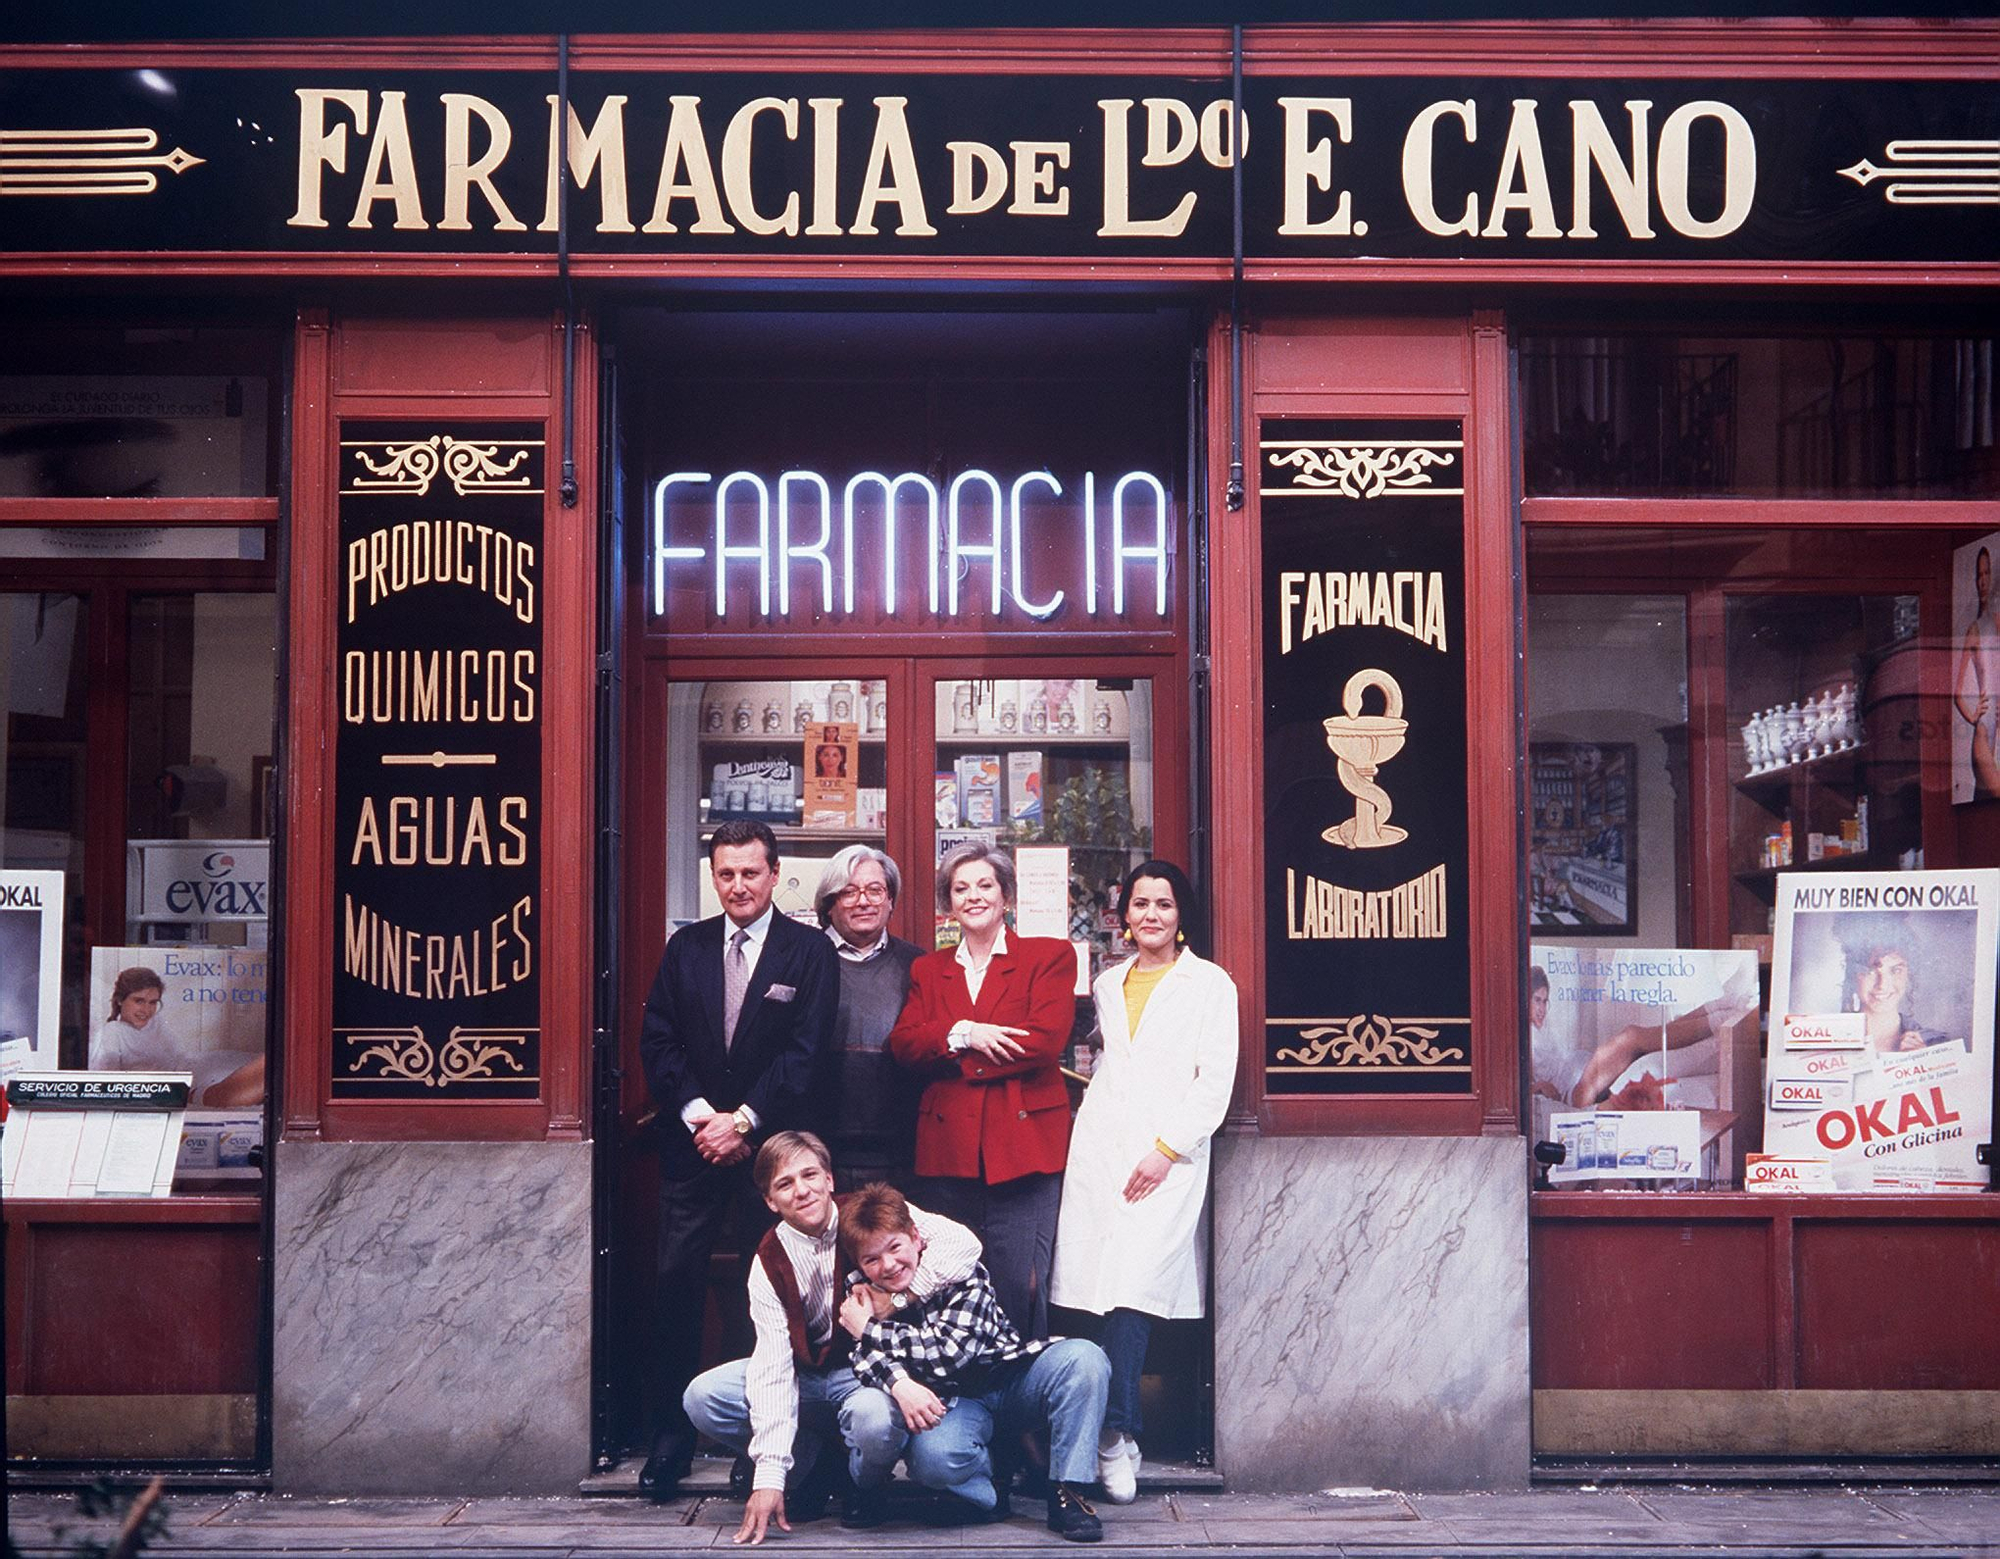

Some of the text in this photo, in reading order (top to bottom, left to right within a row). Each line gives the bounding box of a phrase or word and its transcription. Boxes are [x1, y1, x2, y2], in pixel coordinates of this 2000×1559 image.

[286, 88, 938, 238] FARMACIA
[946, 141, 1069, 215] DE
[1277, 97, 1369, 237] E.
[1401, 98, 1757, 240] CANO
[655, 470, 1167, 617] FARMACIA
[348, 520, 534, 624] PRODUCTOS
[1281, 572, 1447, 655] FARMACIA
[346, 650, 534, 725] QUIMICOS
[351, 797, 527, 865] AGUAS
[166, 881, 266, 914] evax
[1287, 863, 1447, 939] LABORATORIO
[1794, 885, 1979, 909] MUY BIEN CON OKAL
[345, 893, 531, 1000] MINERALES
[164, 954, 222, 977] Evax:
[227, 956, 247, 977] lo
[1617, 955, 1695, 981] parecido
[183, 988, 267, 1004] a no ten
[1611, 980, 1627, 1003] la
[1631, 981, 1677, 1008] regla.
[1791, 1027, 1832, 1038] OKAL
[1807, 1056, 1849, 1073] OKAL
[1895, 1065, 1927, 1079] OKAL
[18, 1082, 171, 1093] SERVICIO DE URGENCIA
[1782, 1087, 1823, 1099] OKAL
[1816, 1086, 1960, 1149] OKAL
[1864, 1126, 1963, 1158] Con Glicina
[1756, 1167, 1799, 1179] OKAL
